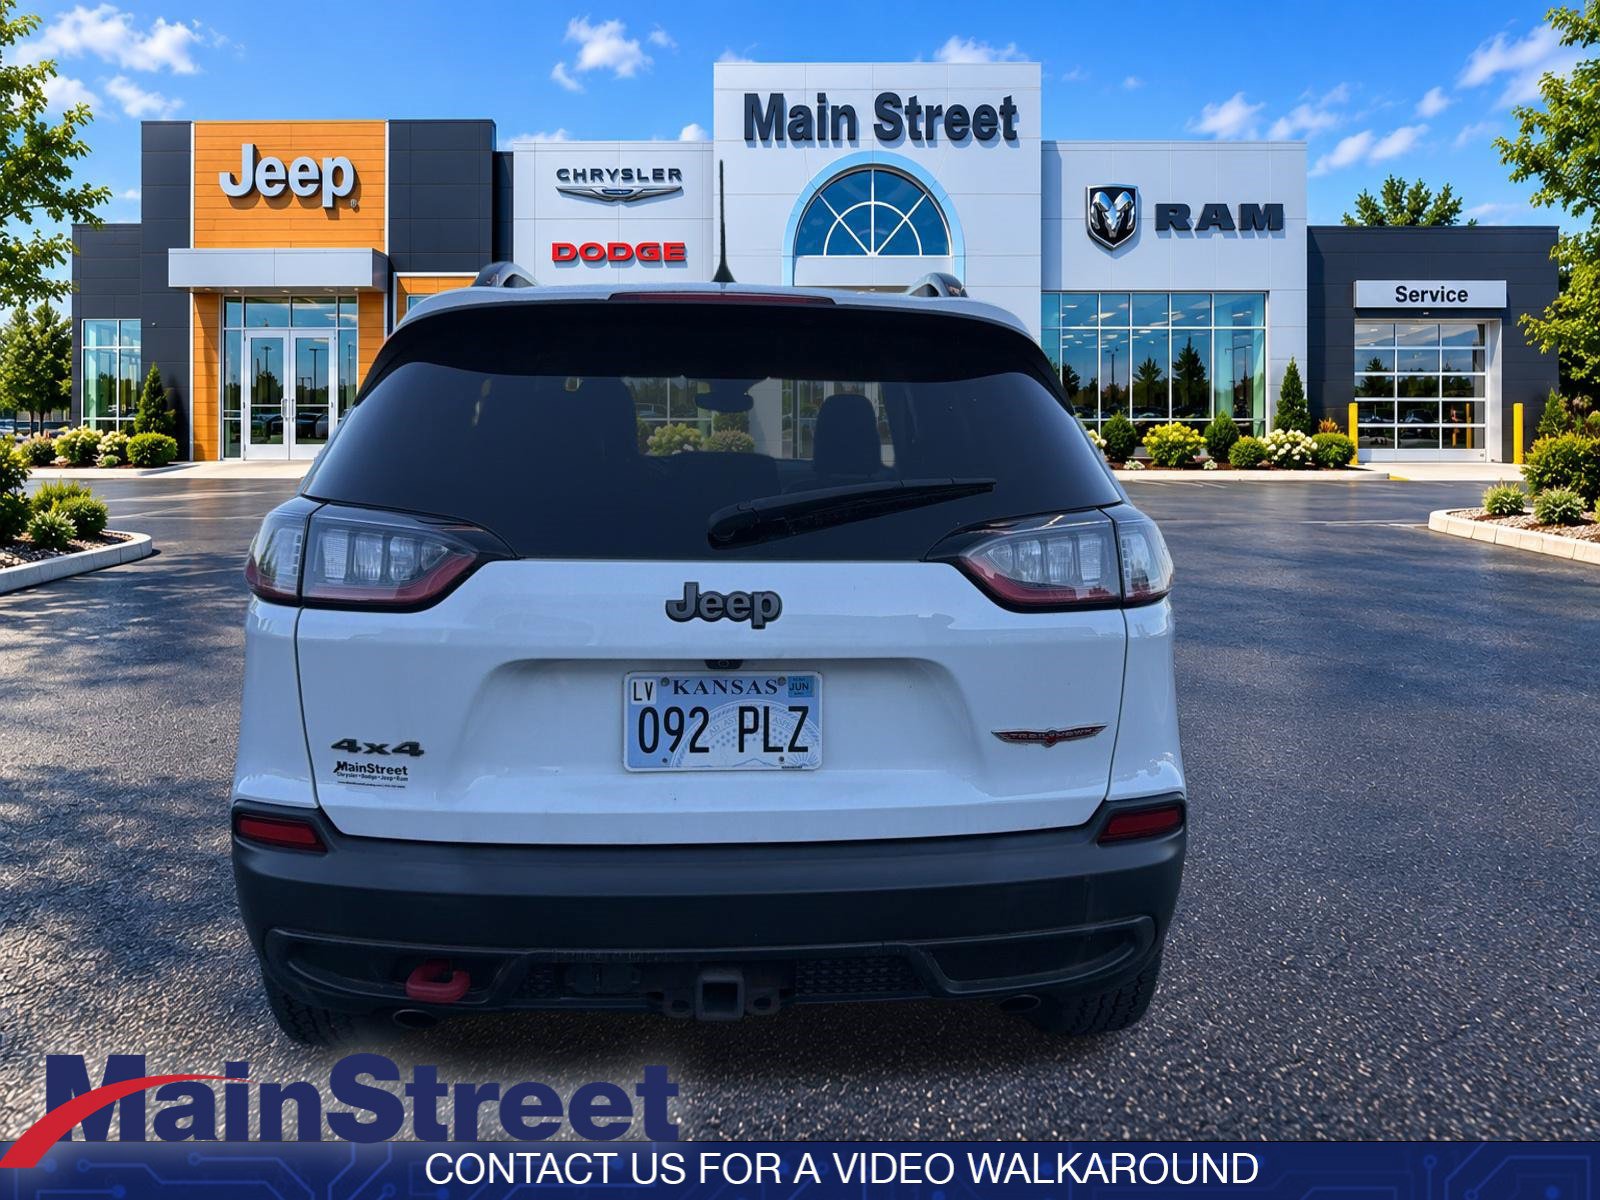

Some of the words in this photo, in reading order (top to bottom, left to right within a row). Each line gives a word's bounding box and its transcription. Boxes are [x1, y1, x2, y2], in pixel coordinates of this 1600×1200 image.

[744, 92, 856, 141] Main
[873, 91, 1017, 141] Street
[218, 143, 355, 208] Jeep
[556, 167, 683, 183] CHRYSLER
[1155, 203, 1284, 232] RAM
[551, 242, 686, 263] DODGE
[1395, 285, 1469, 303] Service
[665, 581, 783, 629] Jeep
[633, 681, 654, 701] LV
[673, 679, 779, 695] KANSAS
[789, 682, 809, 691] JUN
[638, 706, 710, 754] 092
[738, 706, 809, 753] PLZ
[333, 760, 408, 775] MainStreet
